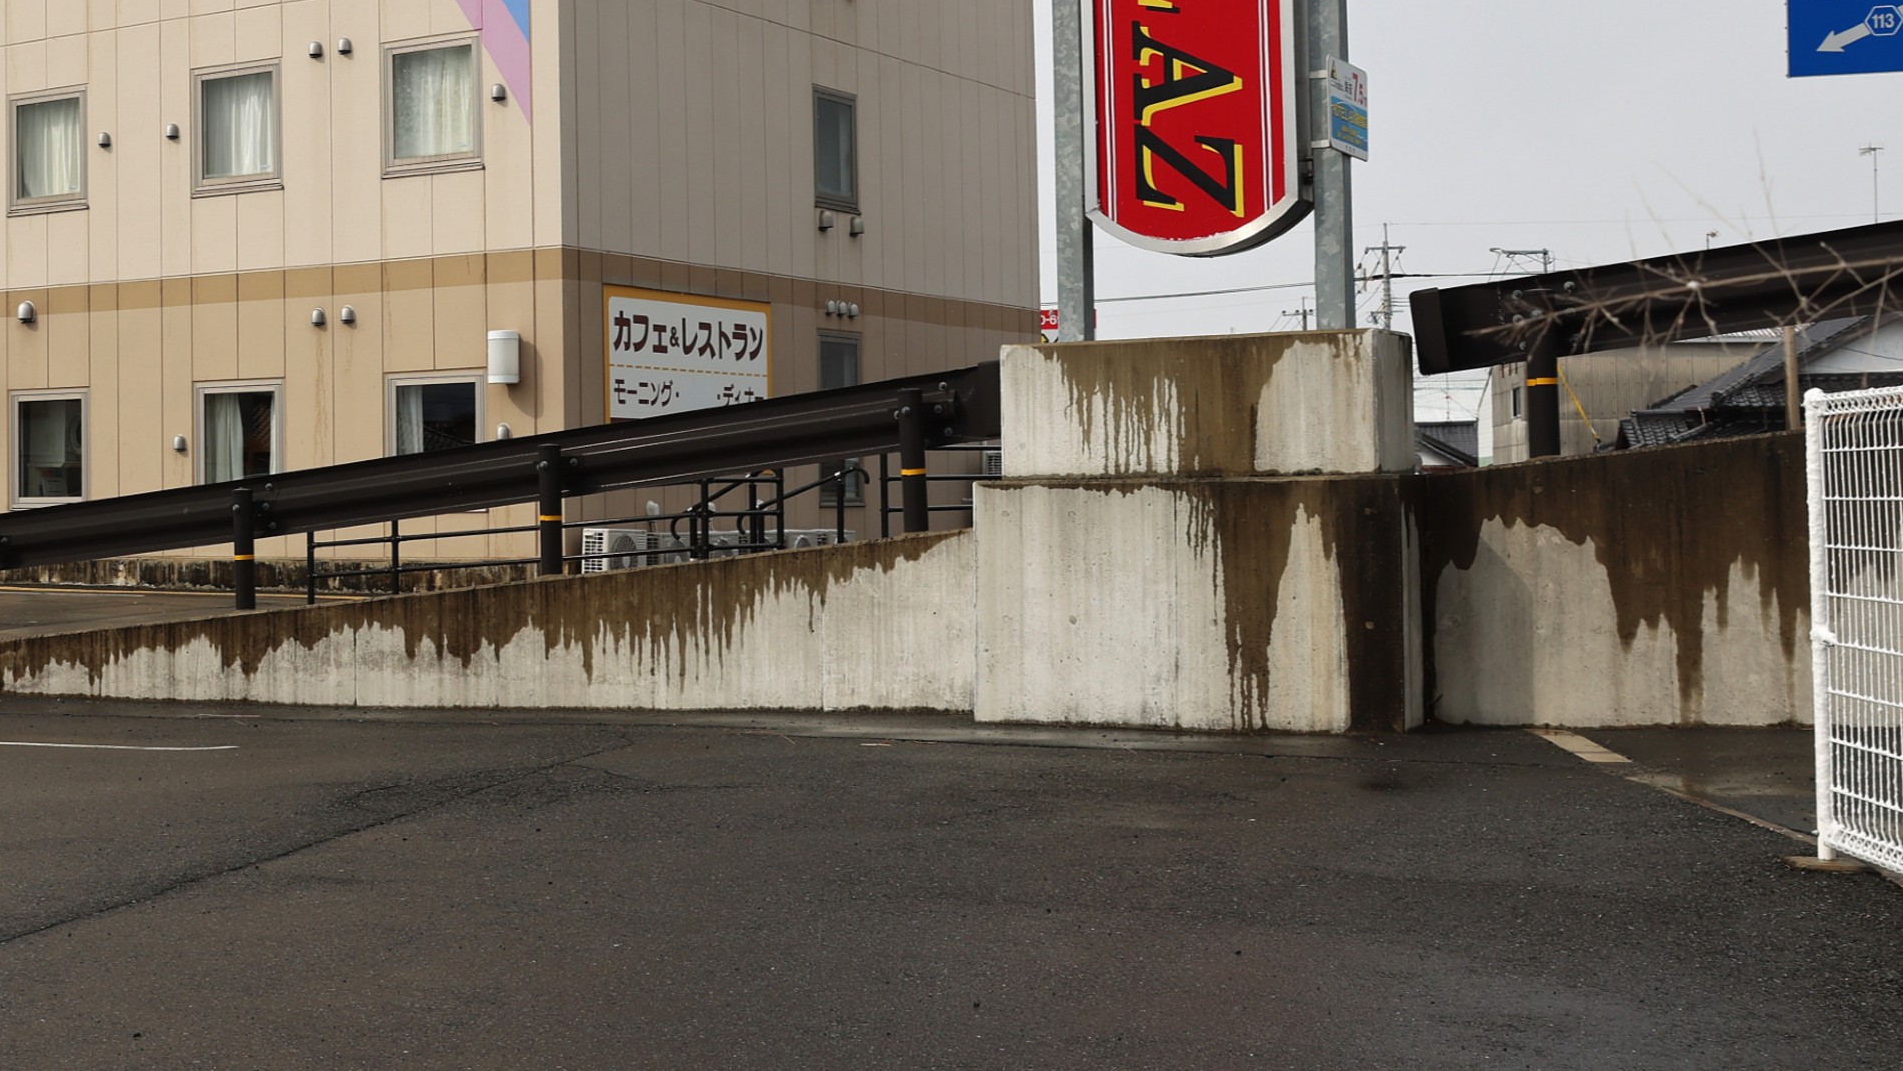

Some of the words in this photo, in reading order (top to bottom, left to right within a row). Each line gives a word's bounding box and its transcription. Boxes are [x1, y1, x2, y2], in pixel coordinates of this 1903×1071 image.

[1872, 13, 1895, 29] 113
[1132, 21, 1245, 218] AZ
[613, 310, 764, 362] カフェ&レストラン
